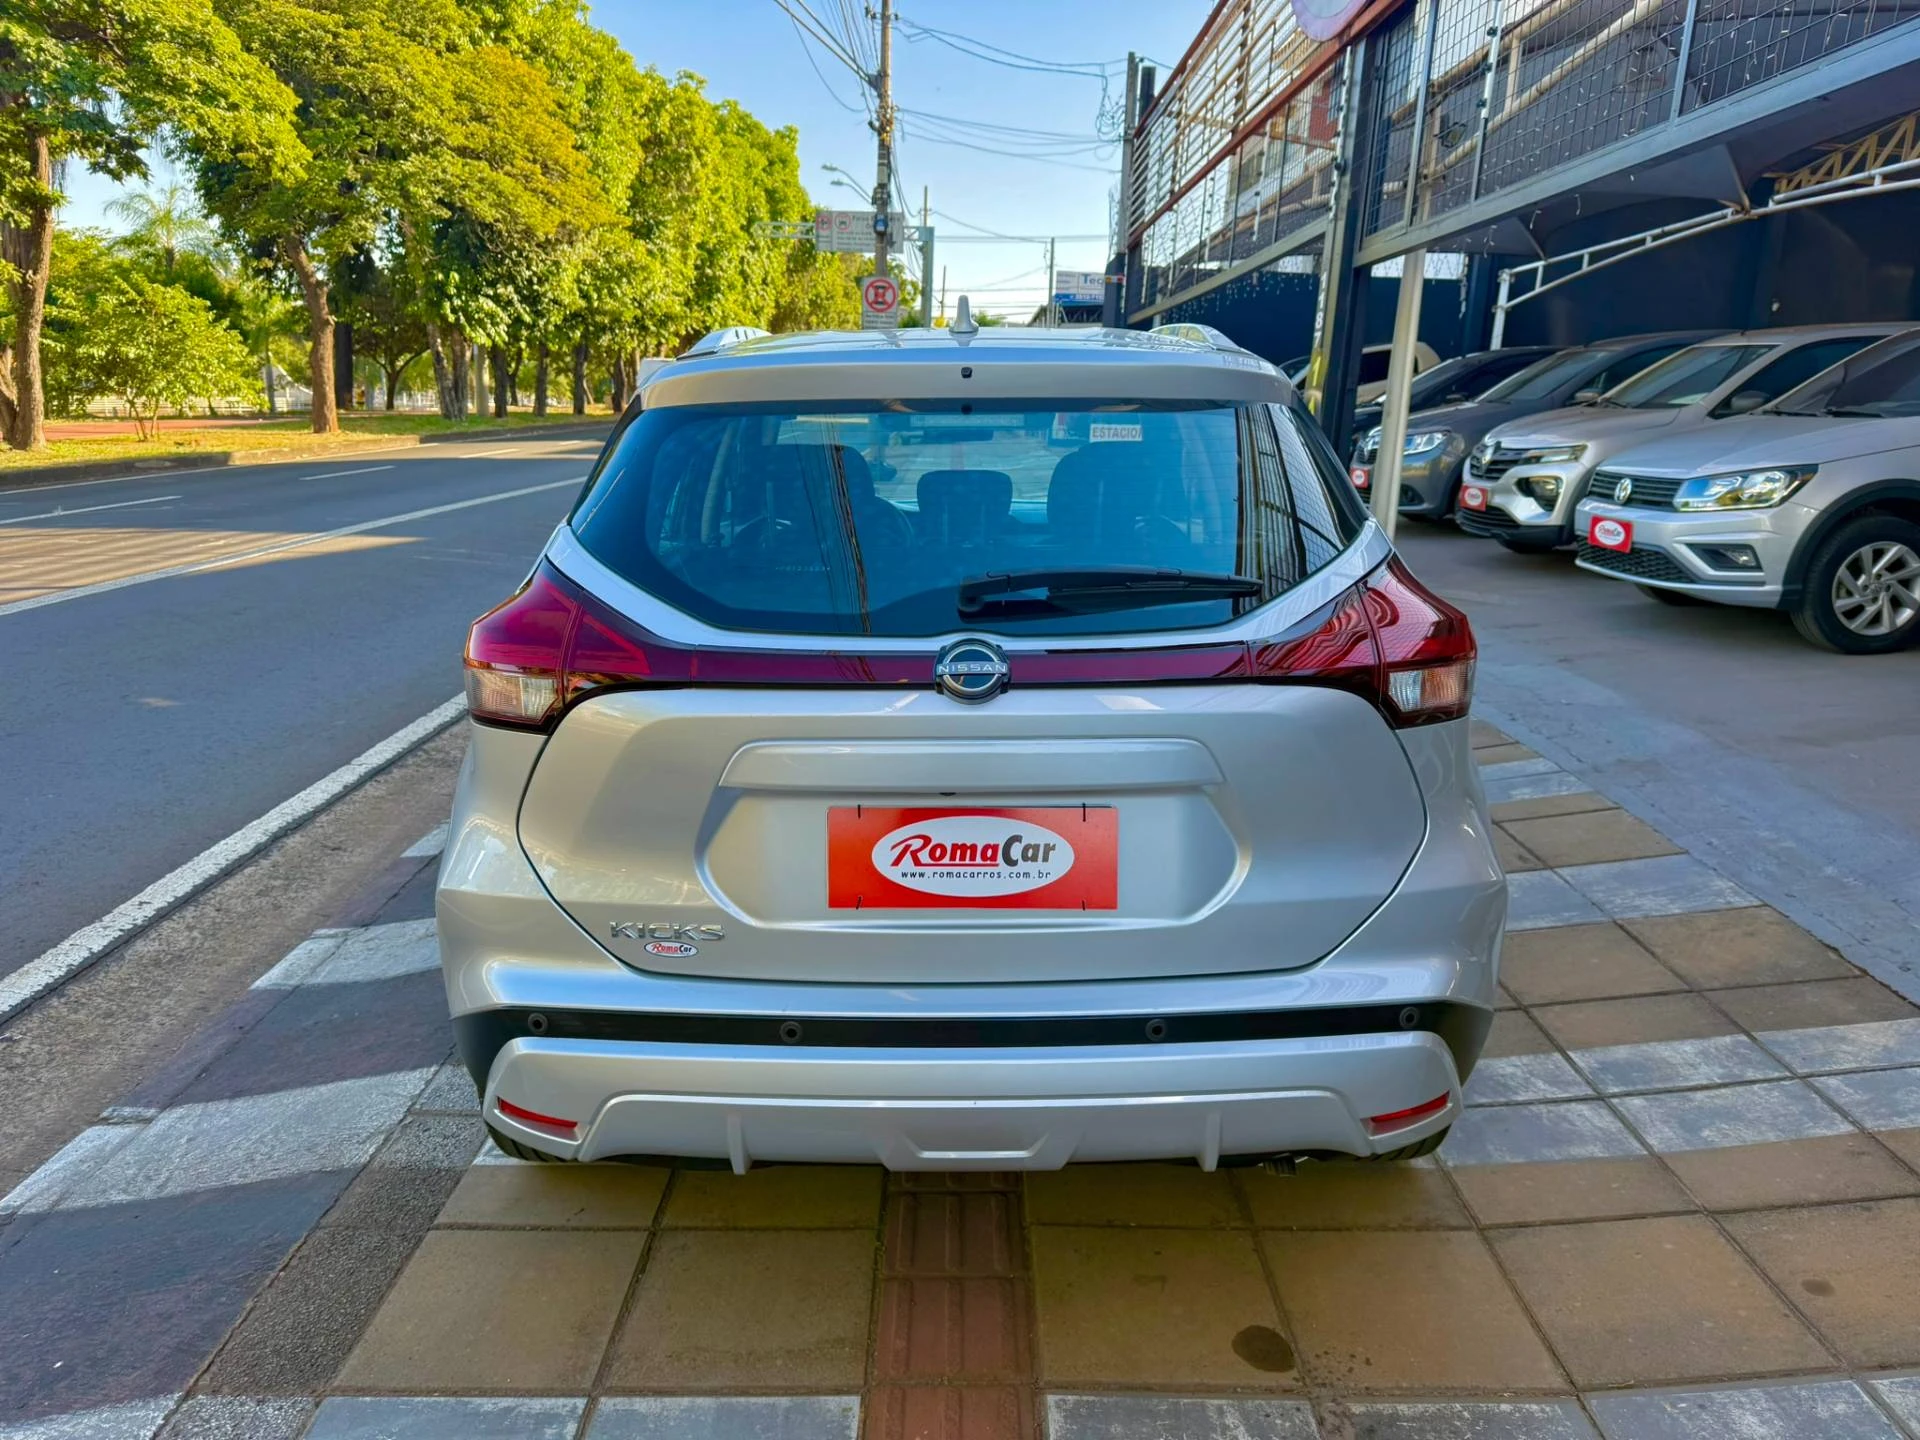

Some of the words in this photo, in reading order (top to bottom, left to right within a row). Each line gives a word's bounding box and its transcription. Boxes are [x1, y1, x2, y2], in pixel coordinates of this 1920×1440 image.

[1314, 271, 1327, 348] 1187
[938, 663, 1006, 673] NISSAN
[890, 834, 1056, 867] RomaCar
[901, 870, 1051, 879] www.romacarros.com.br
[609, 921, 725, 940] KICKS
[651, 942, 692, 953] RomaCar
